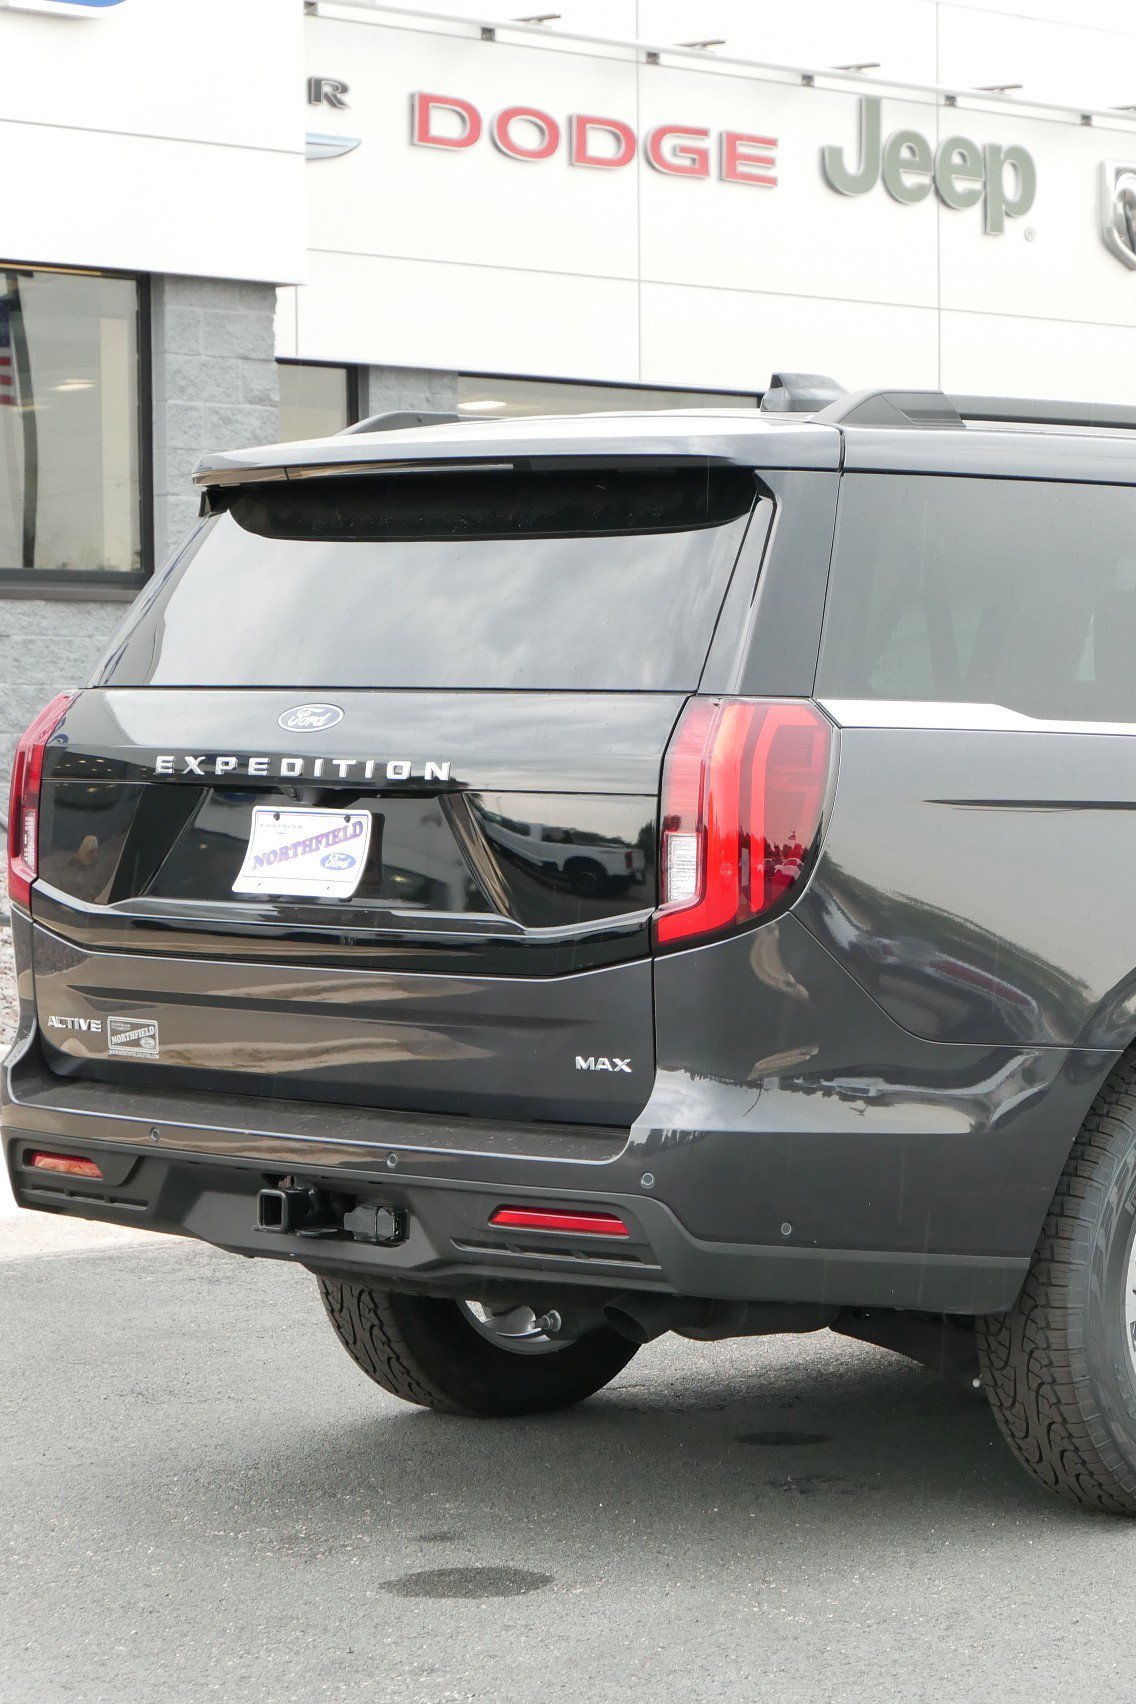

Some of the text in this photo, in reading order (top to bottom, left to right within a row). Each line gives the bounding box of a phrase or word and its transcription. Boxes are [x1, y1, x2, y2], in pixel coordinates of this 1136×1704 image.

[410, 91, 779, 188] DODGE
[821, 96, 1037, 235] Jeep
[285, 706, 335, 728] Ford
[155, 755, 451, 781] EXPEDITION
[252, 820, 364, 870] NORTHFIELD
[48, 1016, 102, 1032] ACTIVE
[111, 1026, 155, 1045] NORTHFIELD
[575, 1056, 632, 1073] MAX
